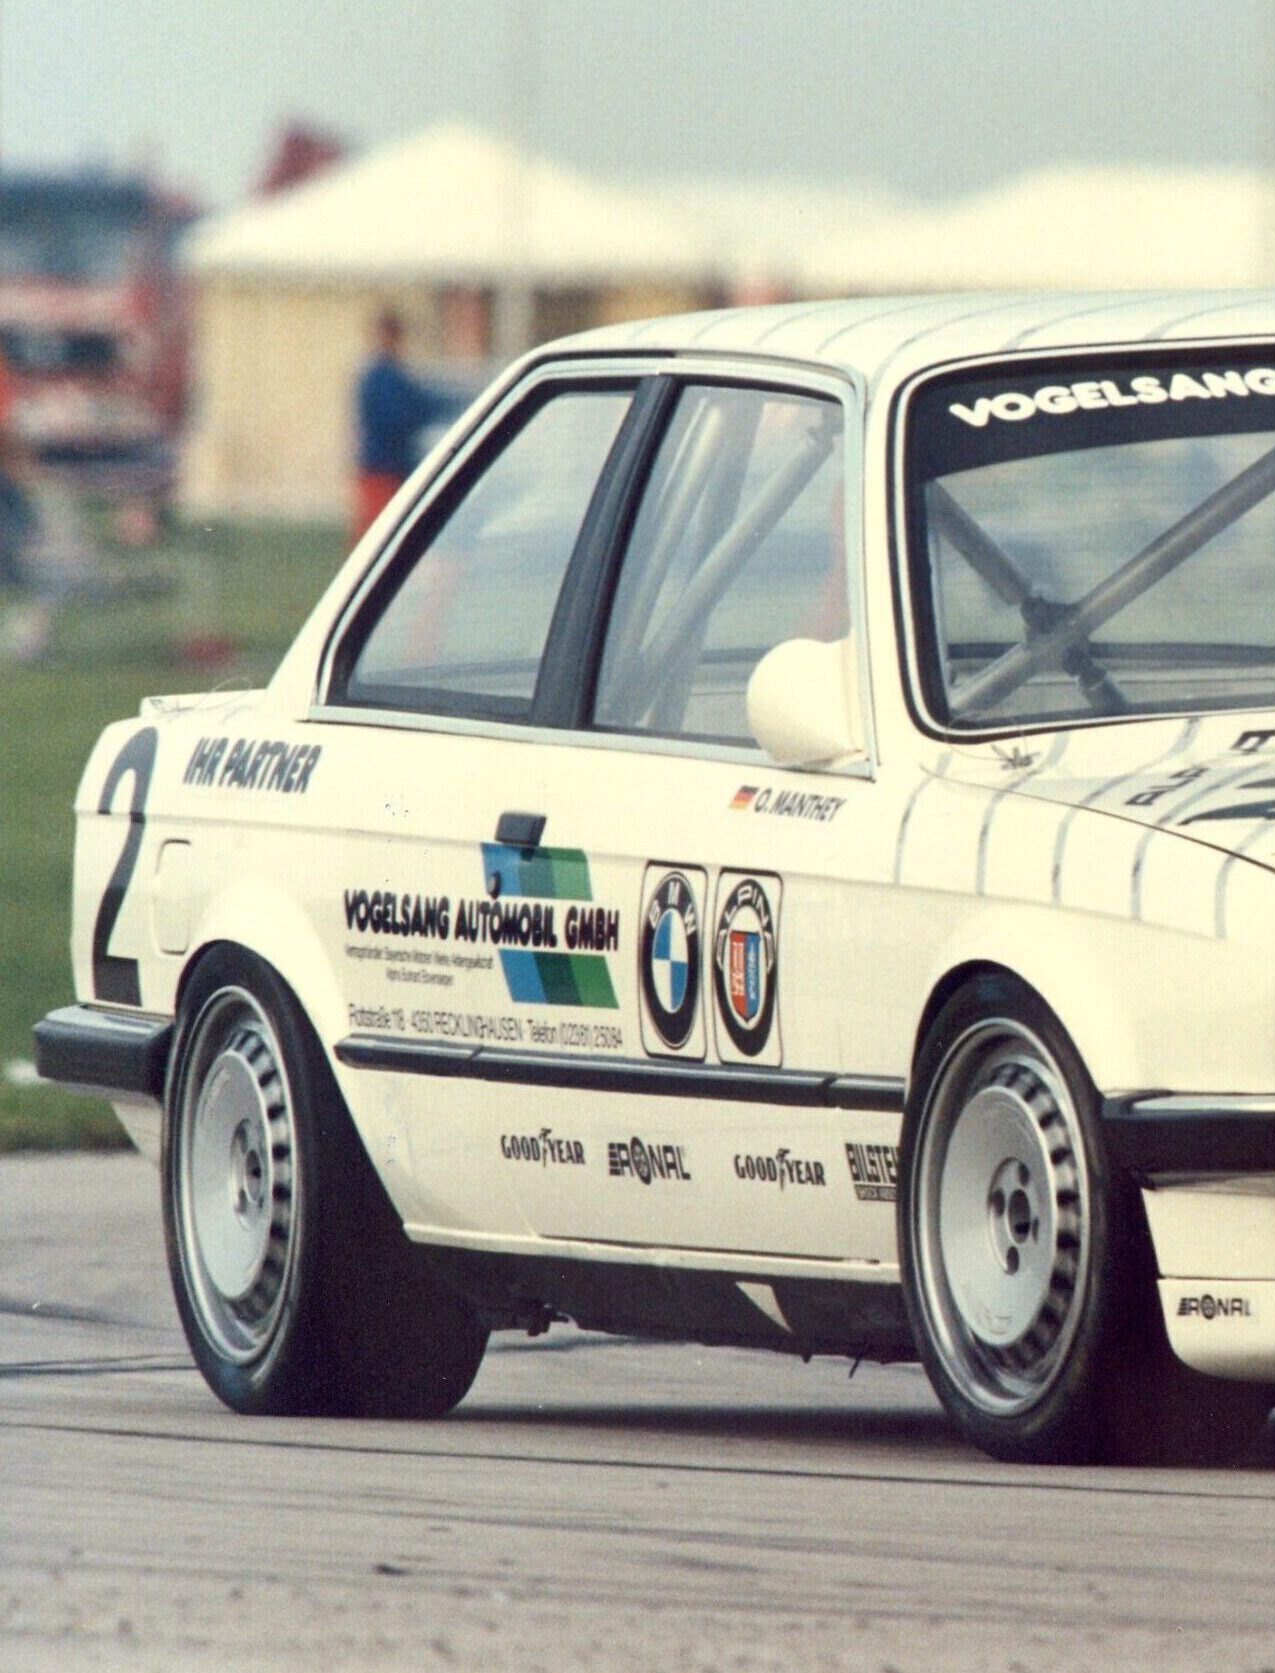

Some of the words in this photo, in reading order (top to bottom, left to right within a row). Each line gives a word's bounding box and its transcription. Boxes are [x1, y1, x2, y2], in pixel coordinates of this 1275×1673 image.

[183, 737, 229, 786] IHR
[219, 738, 323, 793] PARTNER
[94, 727, 158, 1006] 2
[344, 889, 450, 941] VOGELSANG
[454, 899, 558, 949] AUTOMOBIL
[565, 905, 621, 952] GMBH
[649, 881, 698, 935] BMW
